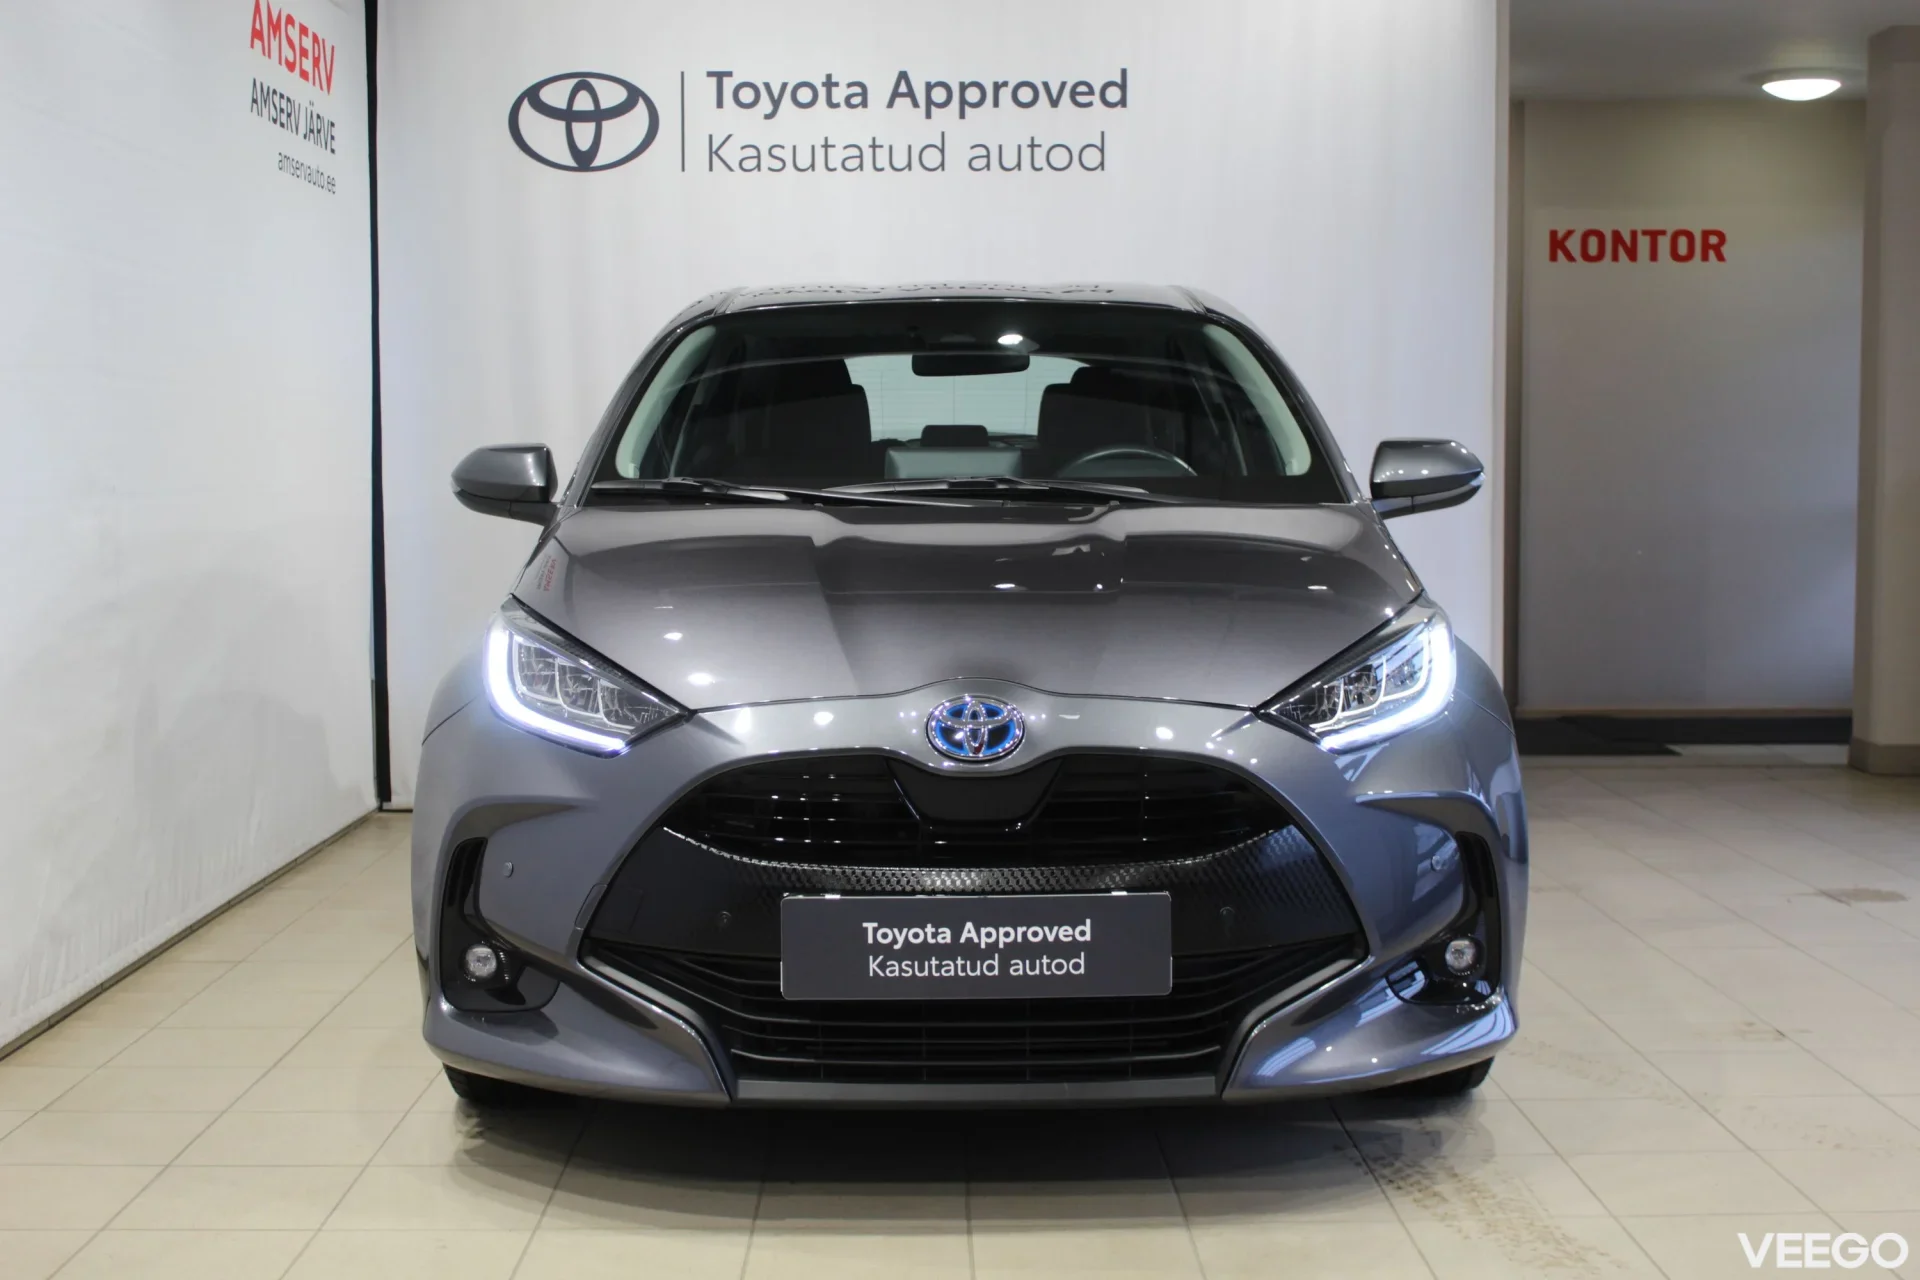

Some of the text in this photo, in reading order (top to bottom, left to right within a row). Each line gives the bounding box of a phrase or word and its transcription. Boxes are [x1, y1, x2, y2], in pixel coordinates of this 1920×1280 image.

[250, 0, 335, 95] AMSERV
[706, 68, 1128, 120] Toyota Approved
[251, 77, 336, 155] AMSERV JÄRVE
[278, 151, 336, 195] amservauto.ee
[708, 131, 1106, 173] Kasutatud autod
[1548, 229, 1727, 263] KONTOR
[862, 918, 1091, 949] Toyota Approved
[869, 951, 1085, 977] Kasutatud autod
